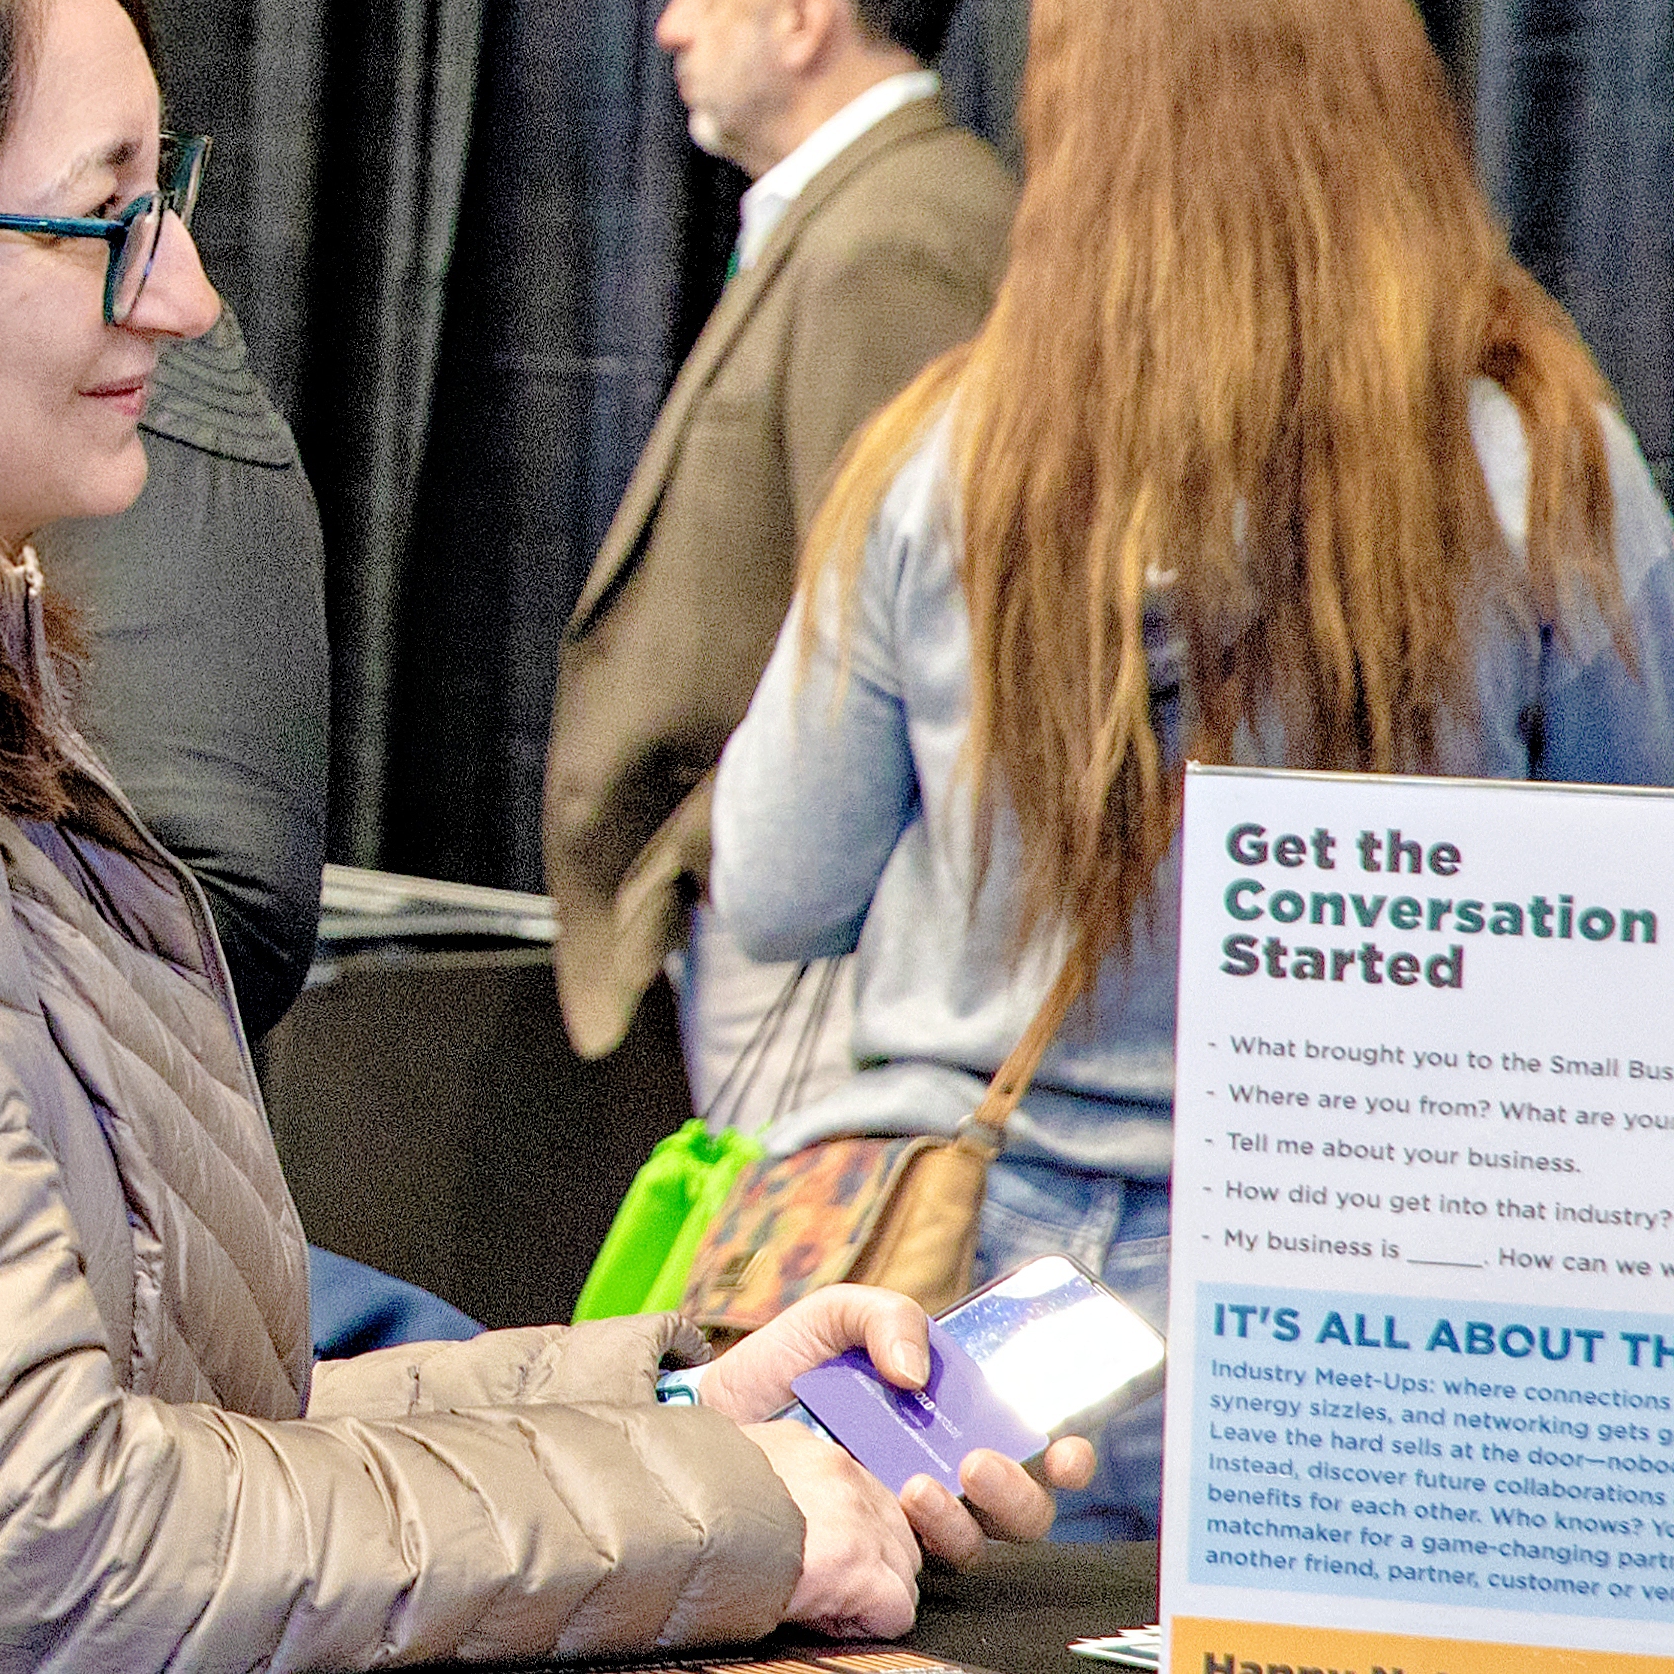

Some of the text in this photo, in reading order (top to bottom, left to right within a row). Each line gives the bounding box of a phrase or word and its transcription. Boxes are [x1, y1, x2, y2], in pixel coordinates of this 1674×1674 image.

[1225, 822, 1462, 877] Get the
[1223, 878, 1658, 944] Conversation
[1219, 934, 1464, 989] Started
[1230, 1035, 1296, 1058] What
[1304, 1039, 1404, 1066] brought
[1413, 1050, 1458, 1069] you
[1466, 1050, 1493, 1070] to
[1500, 1051, 1542, 1073] the
[1549, 1054, 1619, 1077] Small
[1228, 1083, 1310, 1107] Where
[1317, 1093, 1357, 1110] are
[1364, 1096, 1410, 1115] you
[1418, 1094, 1491, 1118] from?
[1499, 1100, 1567, 1124] What
[1574, 1109, 1615, 1127] are
[1226, 1131, 1581, 1173] Tell me about your business.
[1225, 1180, 1674, 1231] How did you get into that industry?
[1224, 1228, 1258, 1252] My
[1267, 1230, 1372, 1257] business
[1381, 1238, 1399, 1259] is
[1498, 1247, 1554, 1270] How
[1561, 1255, 1607, 1273] can
[1615, 1259, 1652, 1277] we
[1214, 1303, 1300, 1342] IT'S
[1316, 1311, 1410, 1350] ALL
[1425, 1318, 1605, 1363] ABOUT
[1211, 1359, 1671, 1411] Industry Meet-Ups: where connections
[1210, 1394, 1301, 1418] synergy
[1309, 1397, 1393, 1424] sizzles,
[1401, 1407, 1445, 1426] and
[1453, 1411, 1590, 1441] networking
[1596, 1422, 1650, 1443] gets
[1210, 1422, 1277, 1444] Leave
[1285, 1428, 1323, 1448] the
[1330, 1430, 1383, 1453] hard
[1391, 1437, 1442, 1457] sells
[1449, 1441, 1473, 1460] at
[1481, 1442, 1520, 1464] the
[1209, 1453, 1667, 1507] Instead, discover future collaborations
[1207, 1483, 1302, 1509] benefits
[1309, 1491, 1341, 1511] for
[1350, 1498, 1406, 1517] each
[1413, 1502, 1481, 1523] other.
[1489, 1506, 1547, 1529] Who
[1554, 1510, 1644, 1536] knows?
[1206, 1517, 1352, 1544] matchmaker
[1359, 1526, 1393, 1547] for
[1400, 1534, 1414, 1549] a
[1421, 1536, 1611, 1569] game-changing
[1205, 1549, 1297, 1569] another
[1304, 1552, 1379, 1580] friend,
[1387, 1564, 1479, 1588] partner,
[1487, 1572, 1600, 1596] customer
[1607, 1582, 1634, 1599] or
